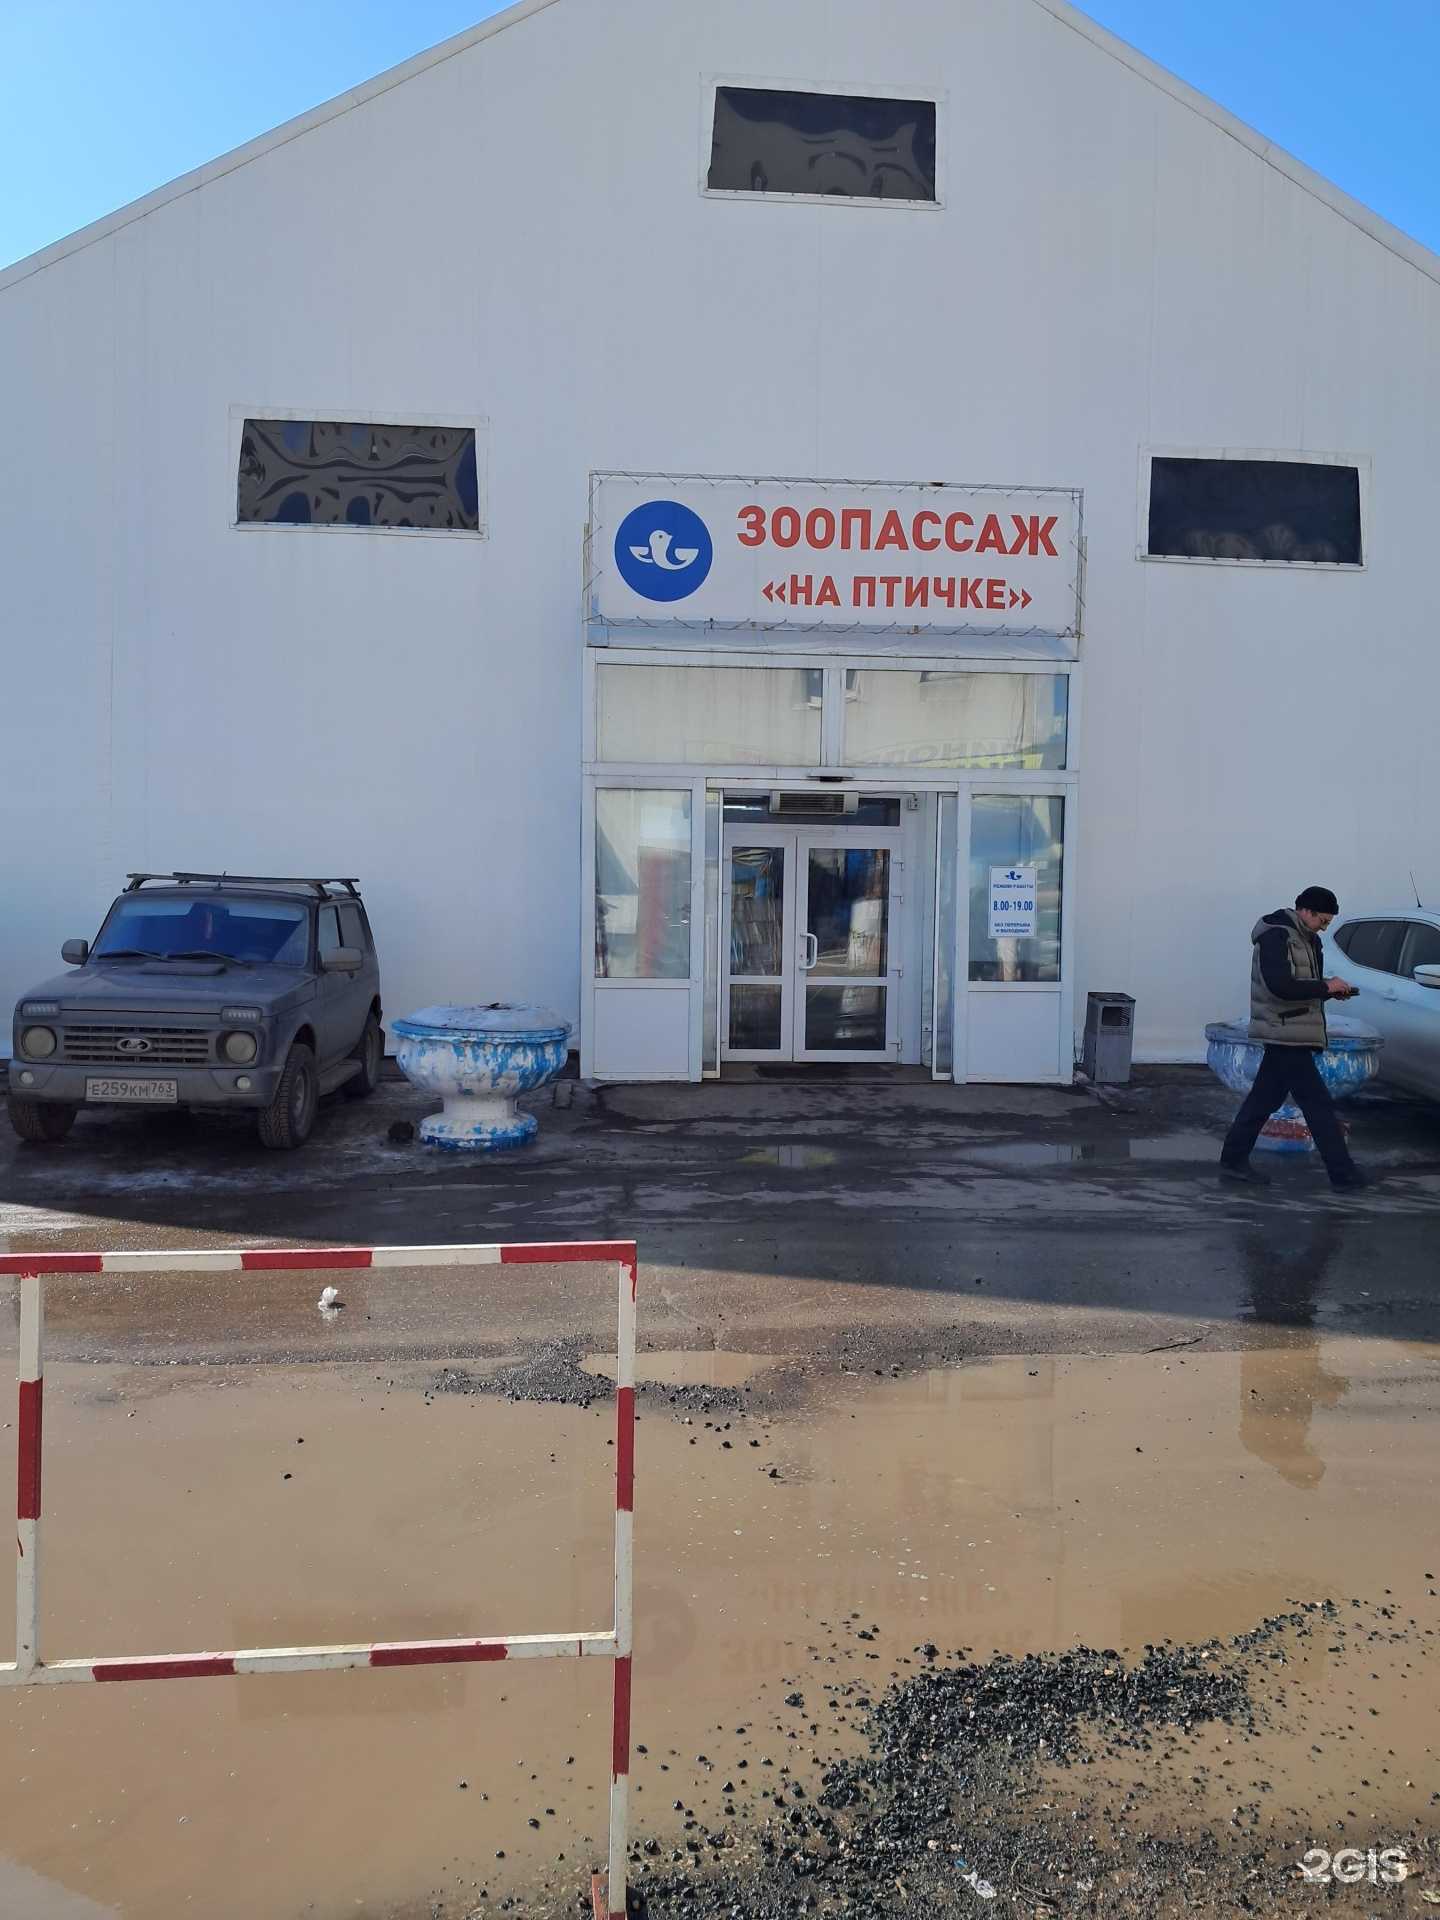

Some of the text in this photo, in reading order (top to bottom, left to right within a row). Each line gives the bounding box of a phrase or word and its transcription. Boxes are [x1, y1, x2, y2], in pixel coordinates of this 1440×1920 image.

[737, 505, 1059, 557] ЗООПАССАЖ
[762, 574, 1033, 609] «НА ПТИЧКЕ»
[993, 900, 1033, 911] 8.00-19.00
